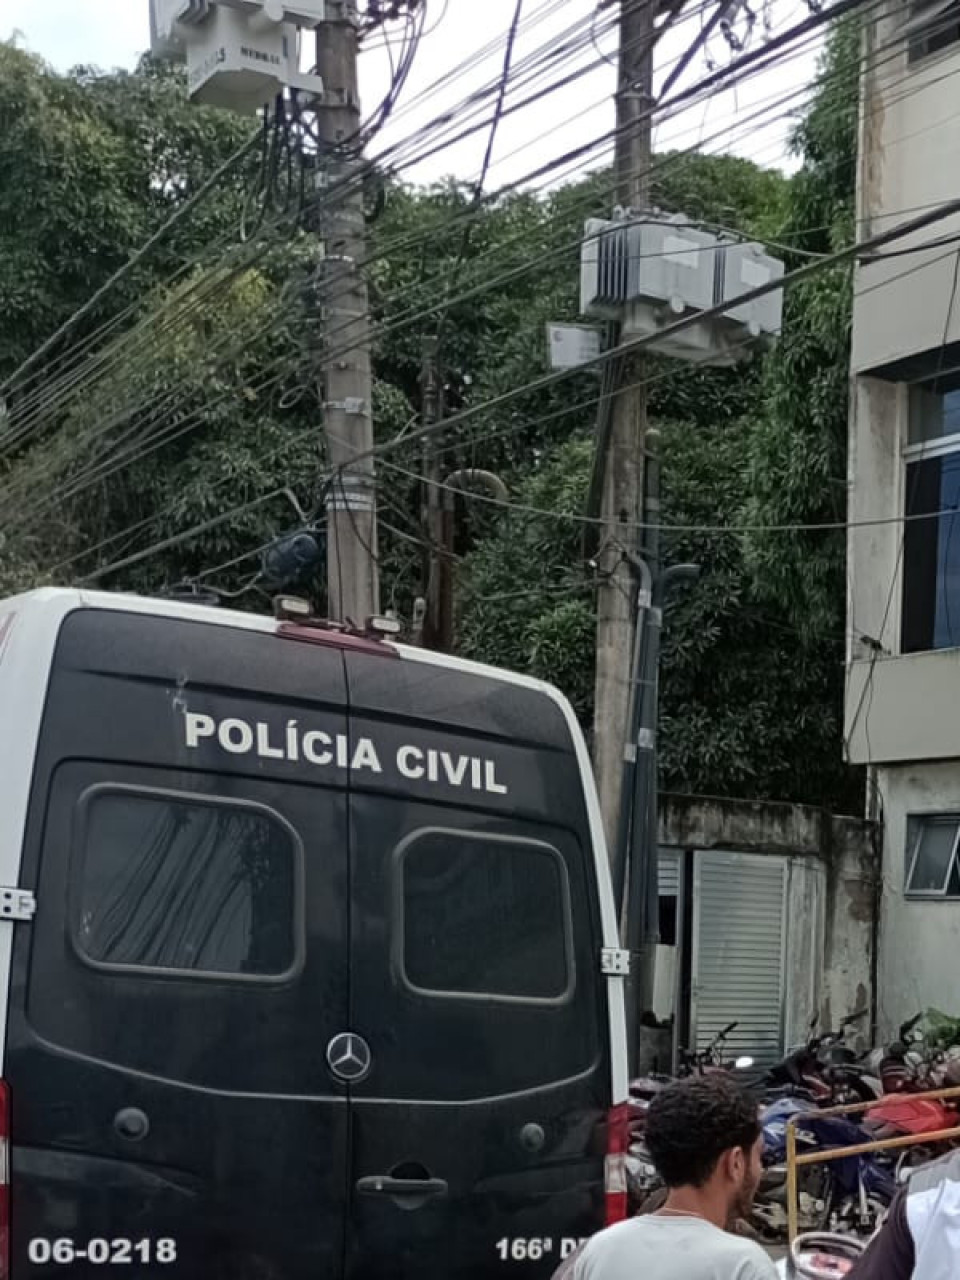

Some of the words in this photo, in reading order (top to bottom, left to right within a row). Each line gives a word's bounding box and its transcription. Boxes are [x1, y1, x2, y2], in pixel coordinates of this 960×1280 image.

[185, 711, 382, 773] POLÍCIA
[396, 744, 508, 795] CIVIL
[28, 1237, 177, 1264] 06-0218
[560, 1237, 592, 1260] D
